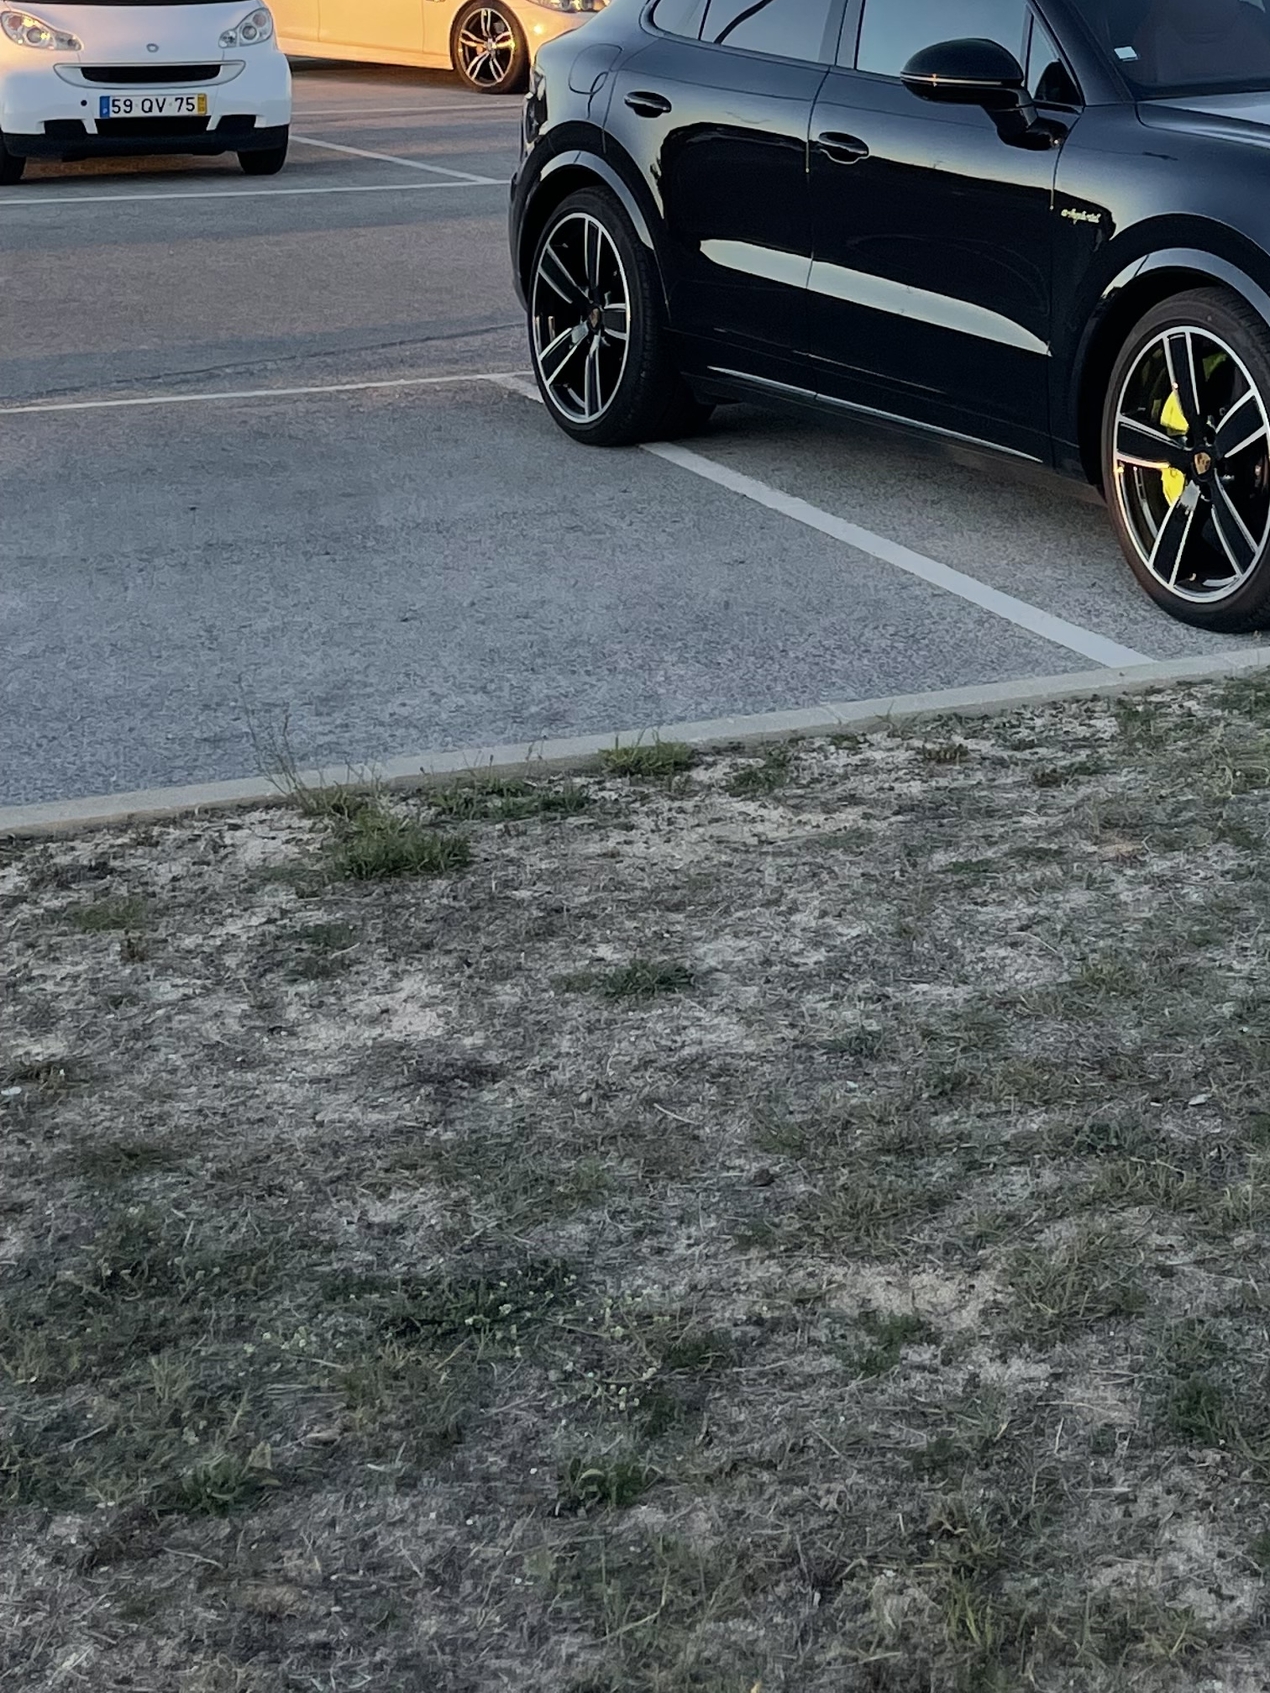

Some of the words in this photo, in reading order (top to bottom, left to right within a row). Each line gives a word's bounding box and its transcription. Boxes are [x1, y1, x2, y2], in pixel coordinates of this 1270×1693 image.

[111, 98, 133, 114] 59
[141, 97, 166, 113] QV
[174, 96, 195, 112] 75
